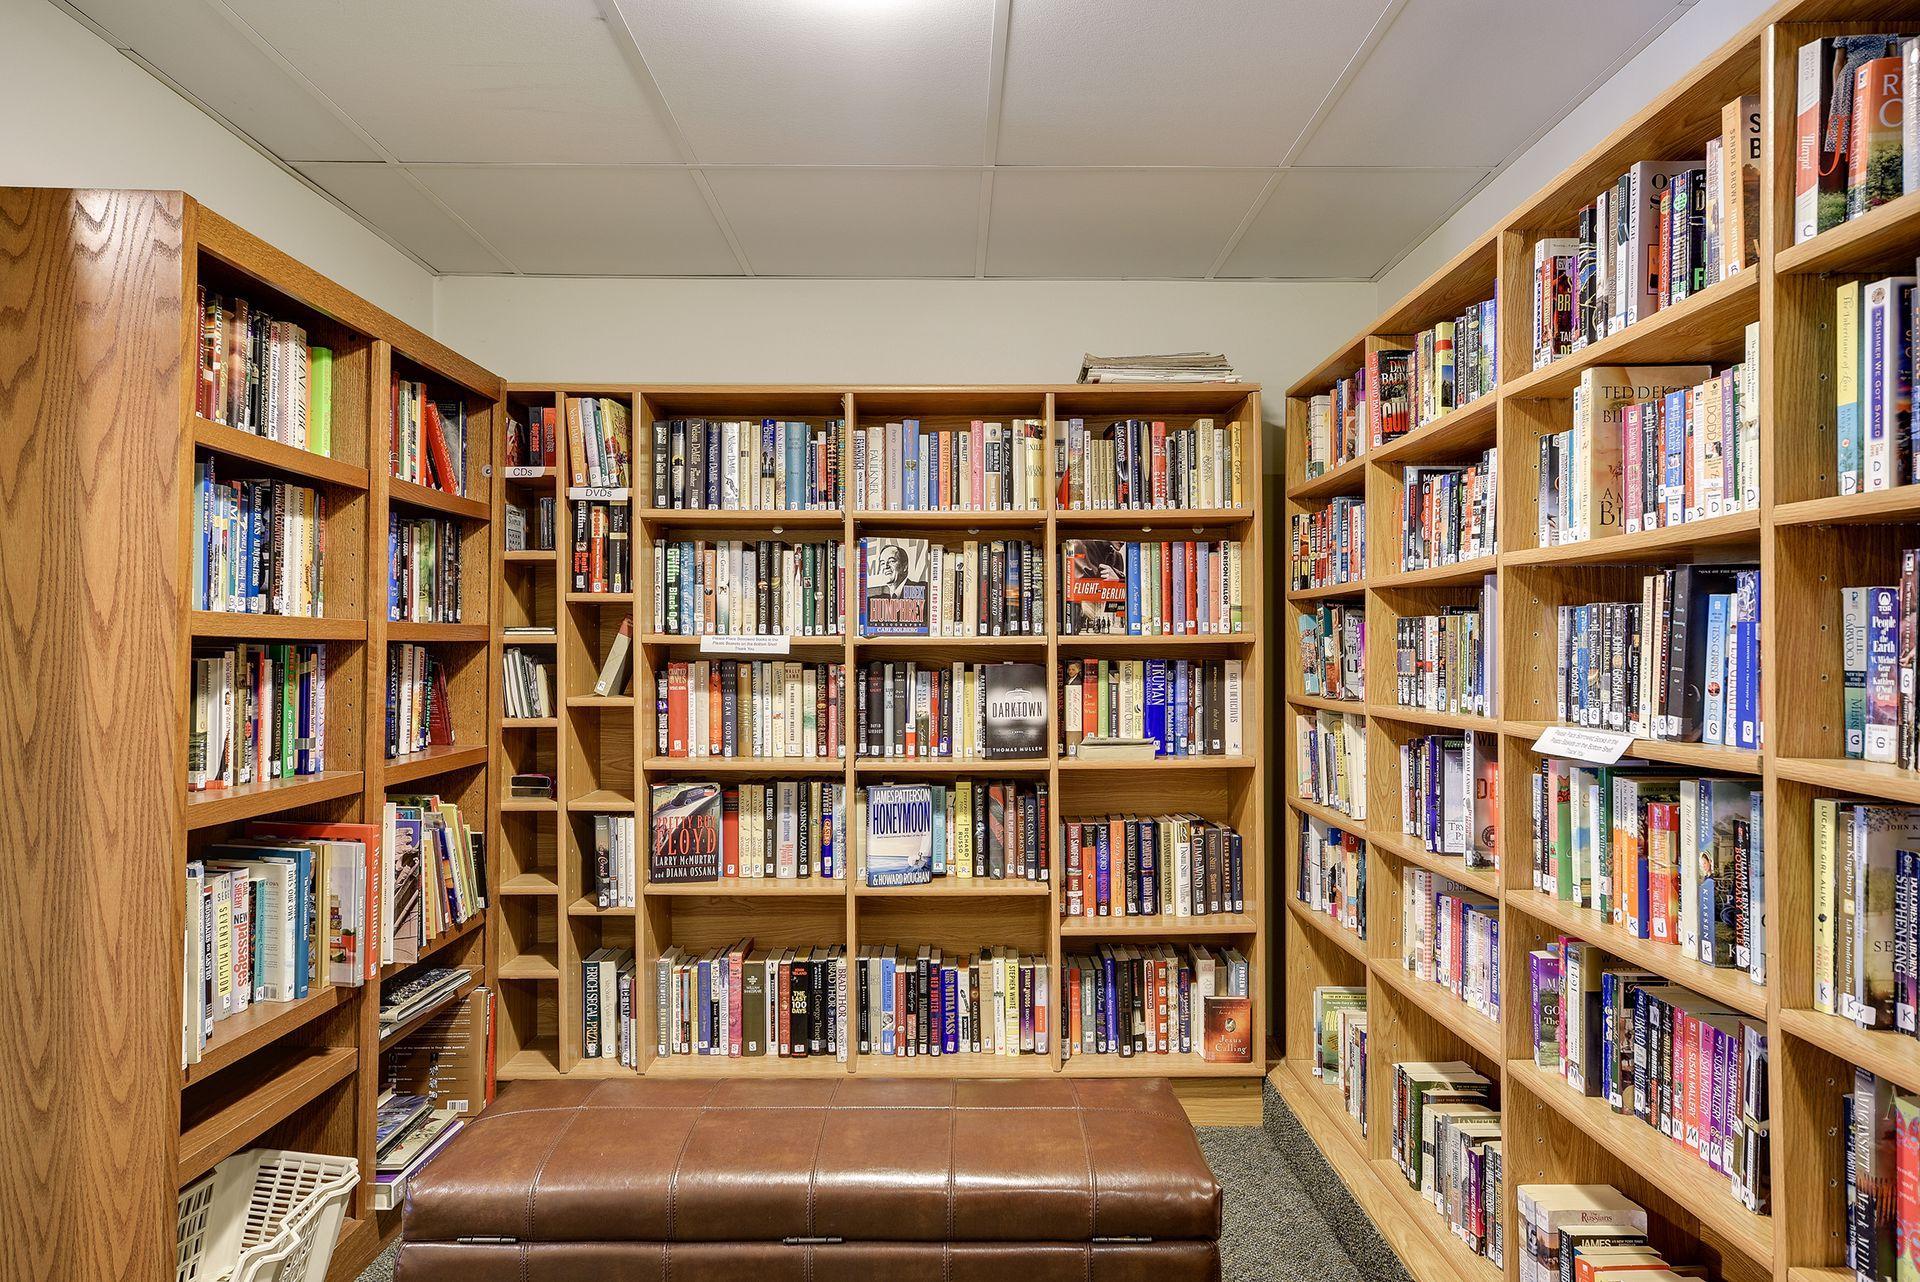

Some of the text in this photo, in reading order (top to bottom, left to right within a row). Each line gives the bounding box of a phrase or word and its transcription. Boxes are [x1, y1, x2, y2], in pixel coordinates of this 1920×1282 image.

[1850, 96, 1863, 169] ROBYN CARR
[1801, 134, 1814, 171] Margot
[1874, 362, 1881, 377] WE
[1602, 386, 1635, 399] TED
[691, 424, 700, 464] Nelson DeMille
[727, 435, 735, 454] Nelson
[1117, 426, 1125, 462] LISA GARDNER
[513, 468, 532, 476] CDs
[709, 444, 718, 483] Nelson DeMille
[870, 450, 878, 495] FAULKNER
[586, 489, 612, 498] DVDs
[577, 501, 586, 528] Griffin
[667, 549, 678, 608] Griffin Black
[1073, 582, 1100, 595] FLIGHT
[759, 594, 767, 607] JOHN
[1101, 587, 1126, 600] BERLIN
[870, 598, 926, 622] HUMPHREY
[1872, 616, 1896, 629] People
[1712, 626, 1720, 643] TESS
[1845, 614, 1856, 667] GARWOOD
[1856, 626, 1865, 655] JULIE
[1872, 642, 1895, 653] Earth
[1614, 636, 1623, 701] JOHN GRISHAM
[1152, 663, 1164, 705] TRUMAN
[992, 701, 1043, 718] DARKTOWN
[873, 789, 930, 803] JAMES PATTERSON
[656, 816, 693, 830] PRETTY
[873, 802, 931, 835] HONEYMOON
[656, 828, 717, 856] FLOYD
[800, 802, 808, 862] RAISING LAZARUS
[1070, 826, 1078, 838] JOHN
[1142, 826, 1151, 838] JOHN
[1847, 820, 1855, 847] Karen
[655, 854, 716, 867] LARRY McMURTRY
[1070, 839, 1078, 866] SANDFORD
[1099, 826, 1107, 870] JOHN SANDFORD
[371, 870, 380, 889] the
[666, 868, 687, 878] DIANA
[689, 866, 717, 876] OSSANA
[879, 873, 903, 885] HOWARD
[1164, 872, 1172, 886] EASY
[1195, 867, 1203, 887] WIND
[1734, 847, 1742, 911] BOUNDARY
[1844, 850, 1855, 896] Kingsbury
[234, 884, 242, 909] SHEEHY
[234, 913, 247, 924] NEW
[370, 892, 380, 951] Children
[1895, 875, 1908, 973] STEPHEN KING
[219, 907, 230, 993] SEVENTH MILLION
[234, 923, 248, 987] passages
[586, 967, 595, 1020] ERICH SEGAL
[838, 969, 846, 1017] BRAD THOR
[813, 995, 822, 1018] George
[945, 1013, 955, 1034] PASS
[1215, 1042, 1248, 1055] Calling
[1219, 1034, 1242, 1044] Jesus
[1688, 1052, 1697, 1117] SUSAN MALLERY
[1700, 1049, 1710, 1118] SUSAN MALLERY
[1713, 1053, 1724, 1121] SUSAN MALLERY
[1857, 1084, 1873, 1274] AMAGANSETT Mark Mills
[1580, 1213, 1613, 1223] Russians
